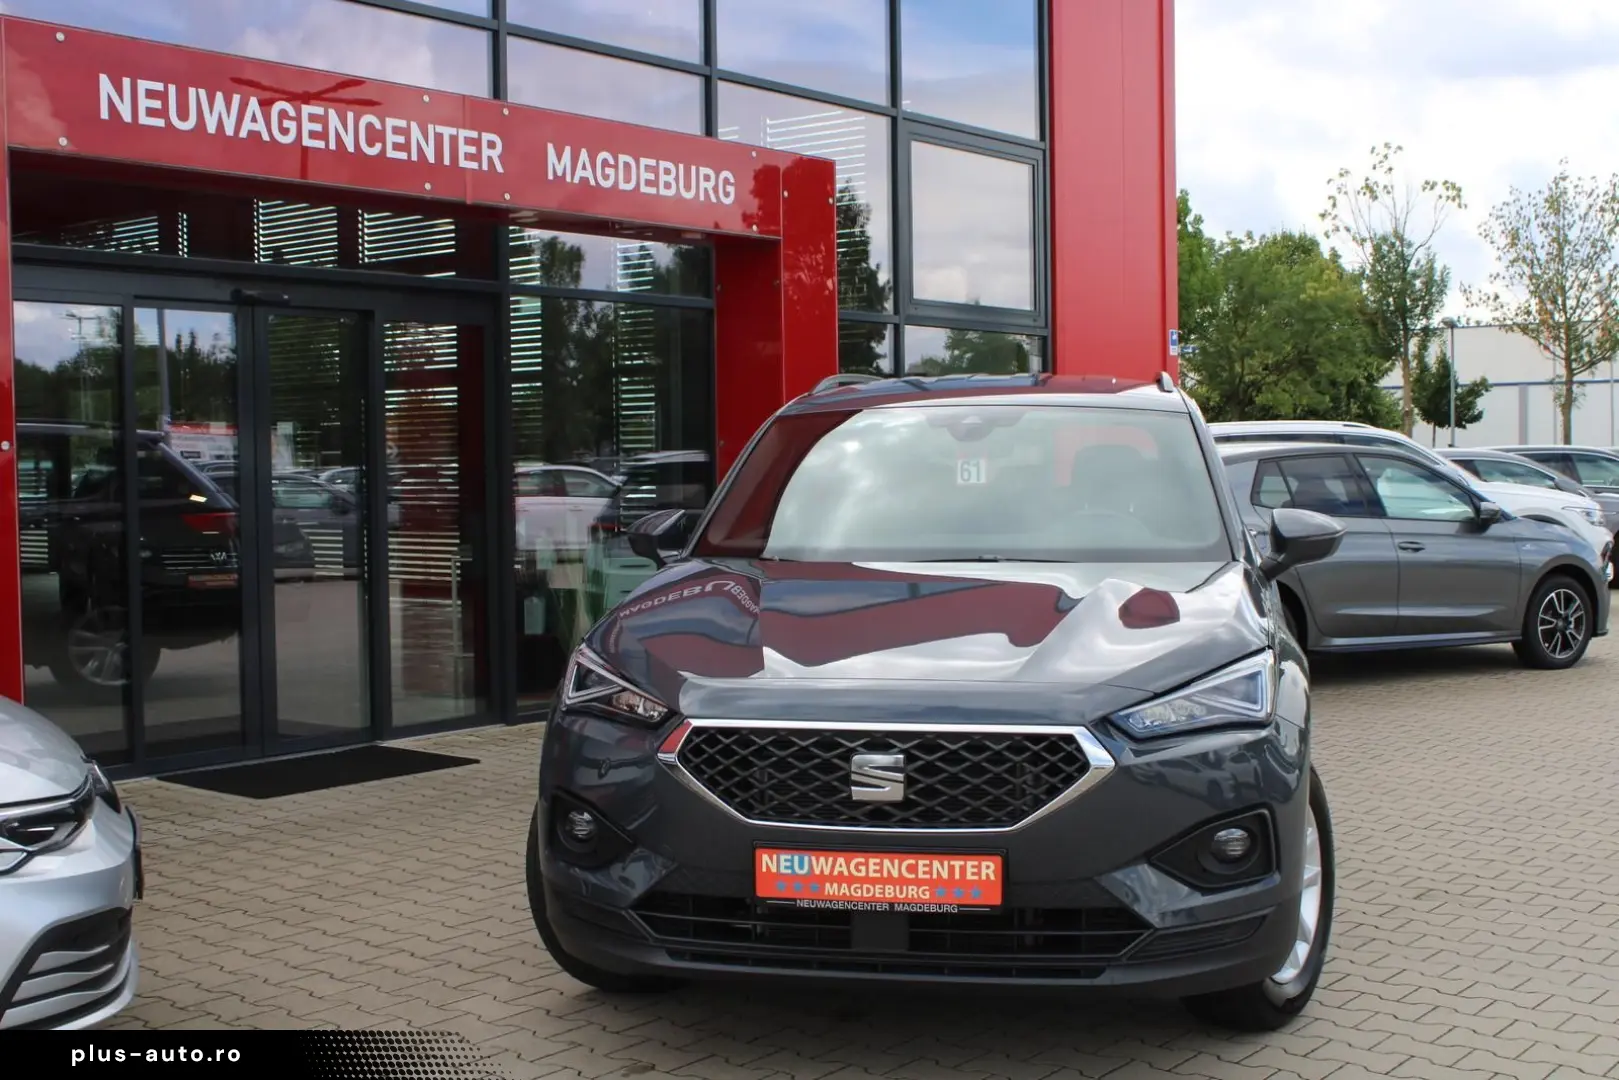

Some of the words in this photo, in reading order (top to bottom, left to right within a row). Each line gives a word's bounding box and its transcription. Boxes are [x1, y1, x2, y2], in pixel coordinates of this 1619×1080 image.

[98, 73, 505, 173] NEUWAGENCENTER
[546, 142, 736, 205] MAGDEBURG
[960, 460, 981, 483] 61
[761, 853, 996, 881] NEUWAGENCENTER
[824, 882, 930, 899] MAGDEBURG
[796, 899, 889, 911] NEUWAGENCENTER
[894, 902, 959, 913] MAGDEBURG
